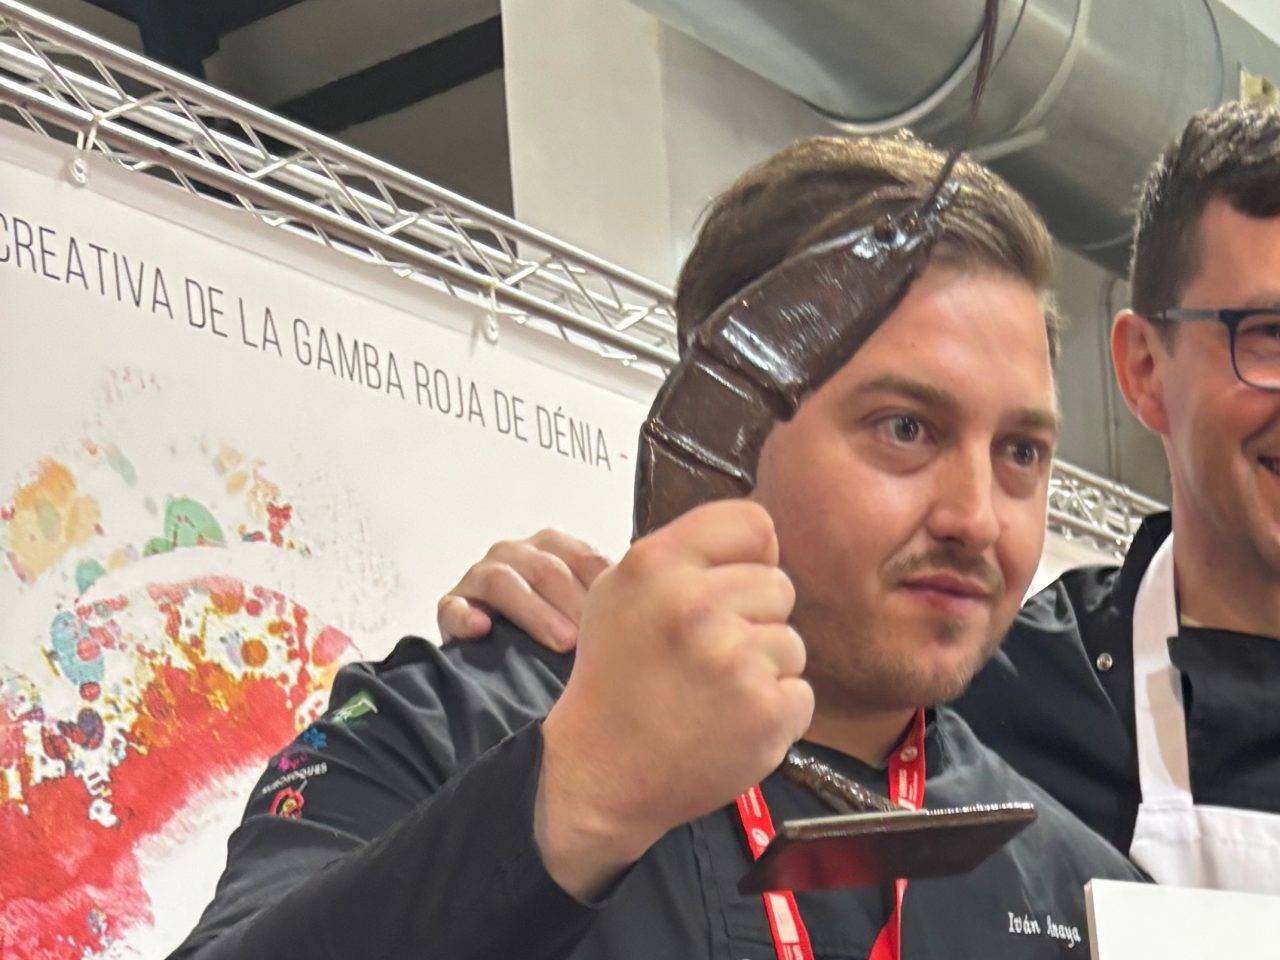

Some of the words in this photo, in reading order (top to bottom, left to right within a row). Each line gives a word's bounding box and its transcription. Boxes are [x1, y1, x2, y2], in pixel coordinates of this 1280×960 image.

[185, 277, 228, 338] DE
[239, 296, 283, 357] LA
[293, 318, 404, 399] GAMBA
[414, 360, 486, 428] ROJA
[493, 389, 528, 442] DE
[536, 404, 612, 471] DÉNIA
[1008, 911, 1041, 935] Iván
